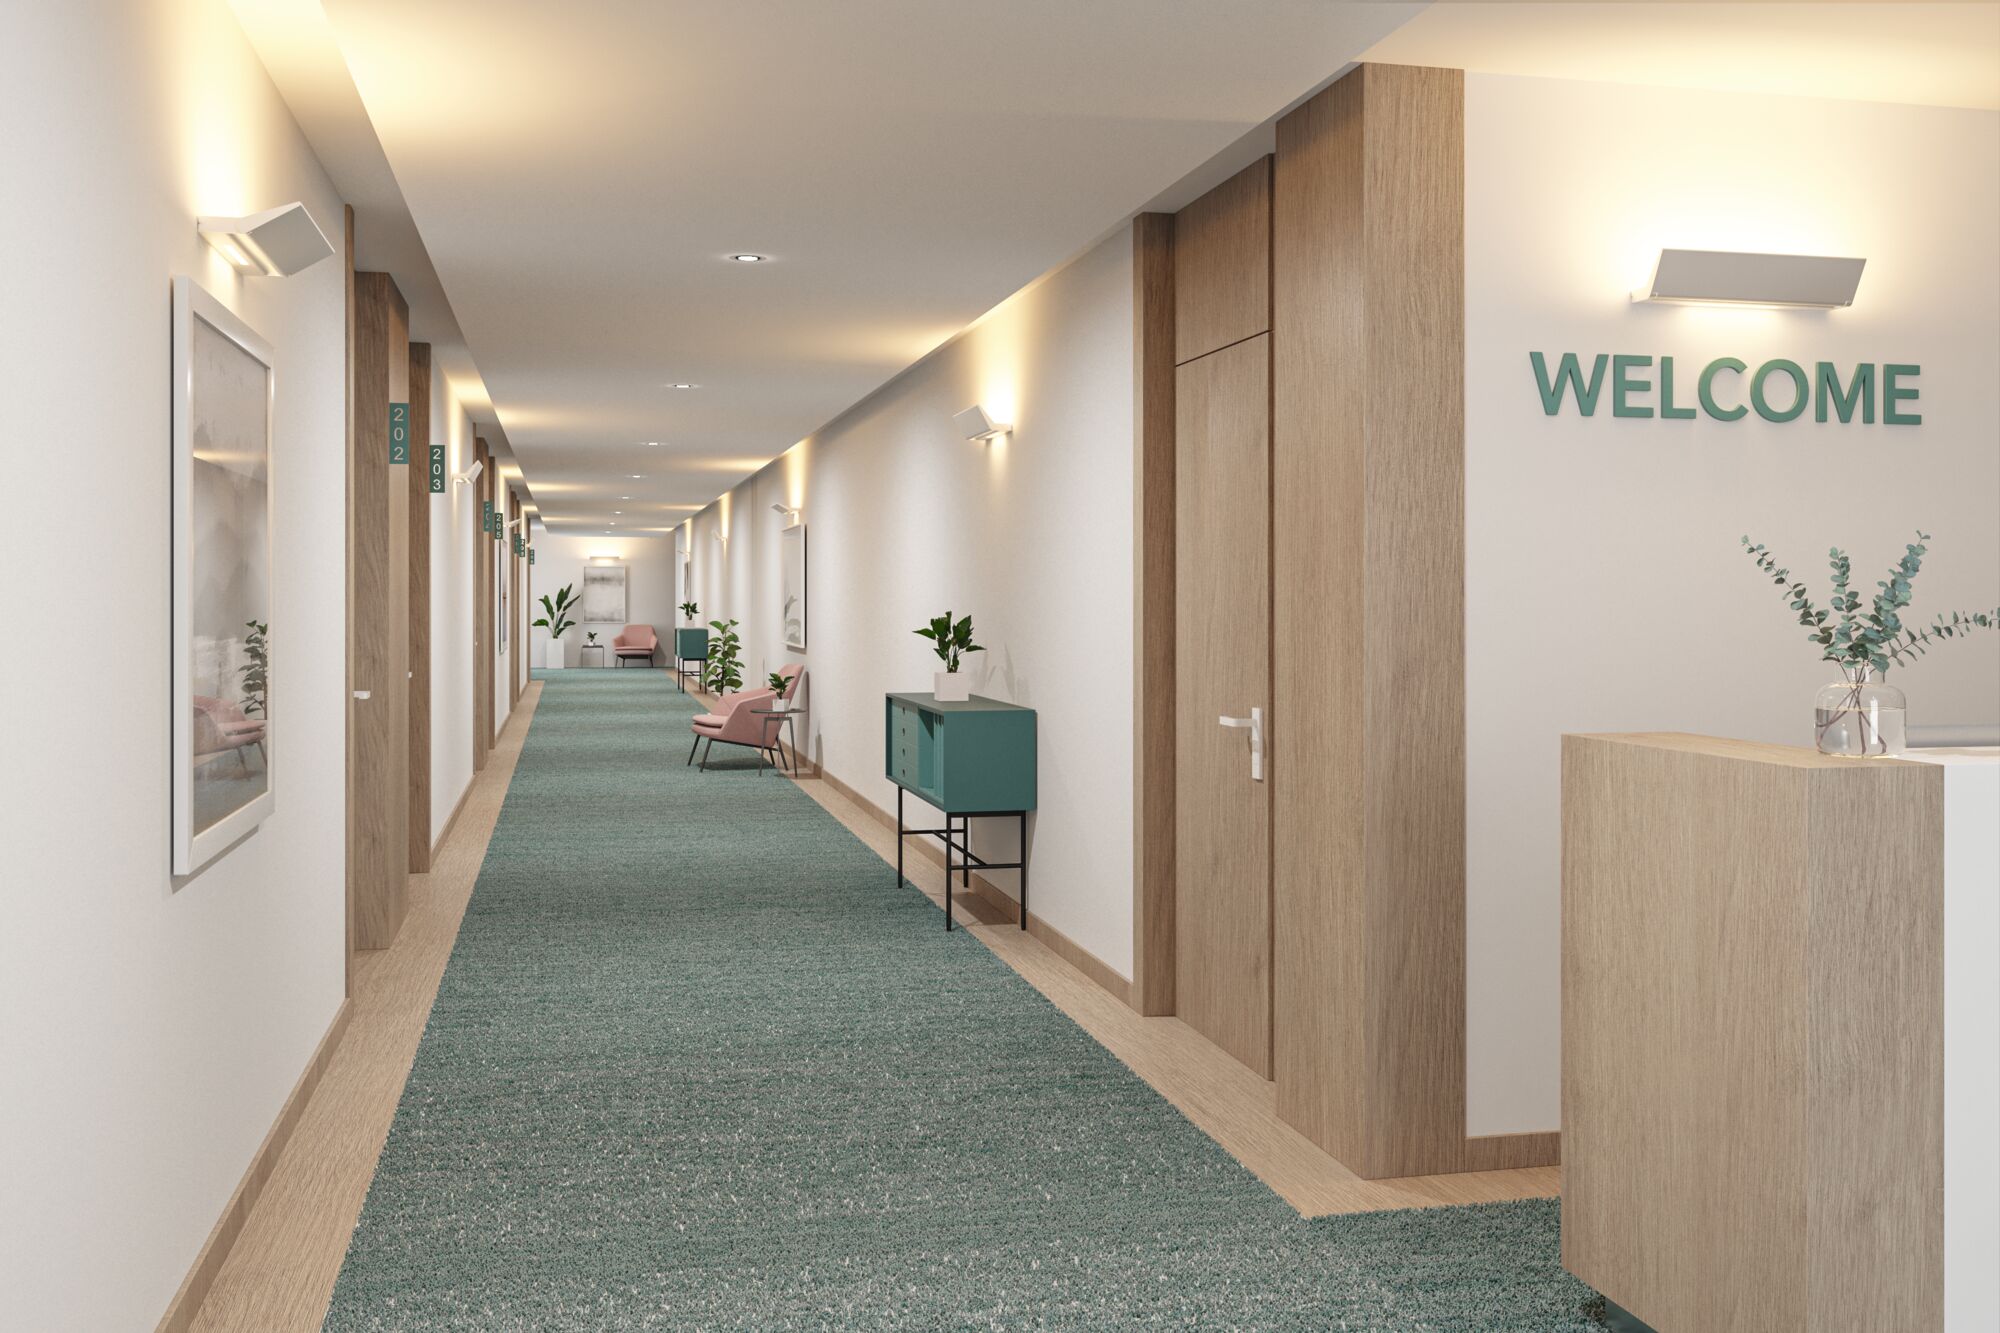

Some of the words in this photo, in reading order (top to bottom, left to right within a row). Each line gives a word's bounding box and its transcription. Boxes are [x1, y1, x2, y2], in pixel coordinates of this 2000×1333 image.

[1529, 351, 1922, 425] WELCOME
[393, 407, 404, 461] 202
[432, 448, 441, 490] 203
